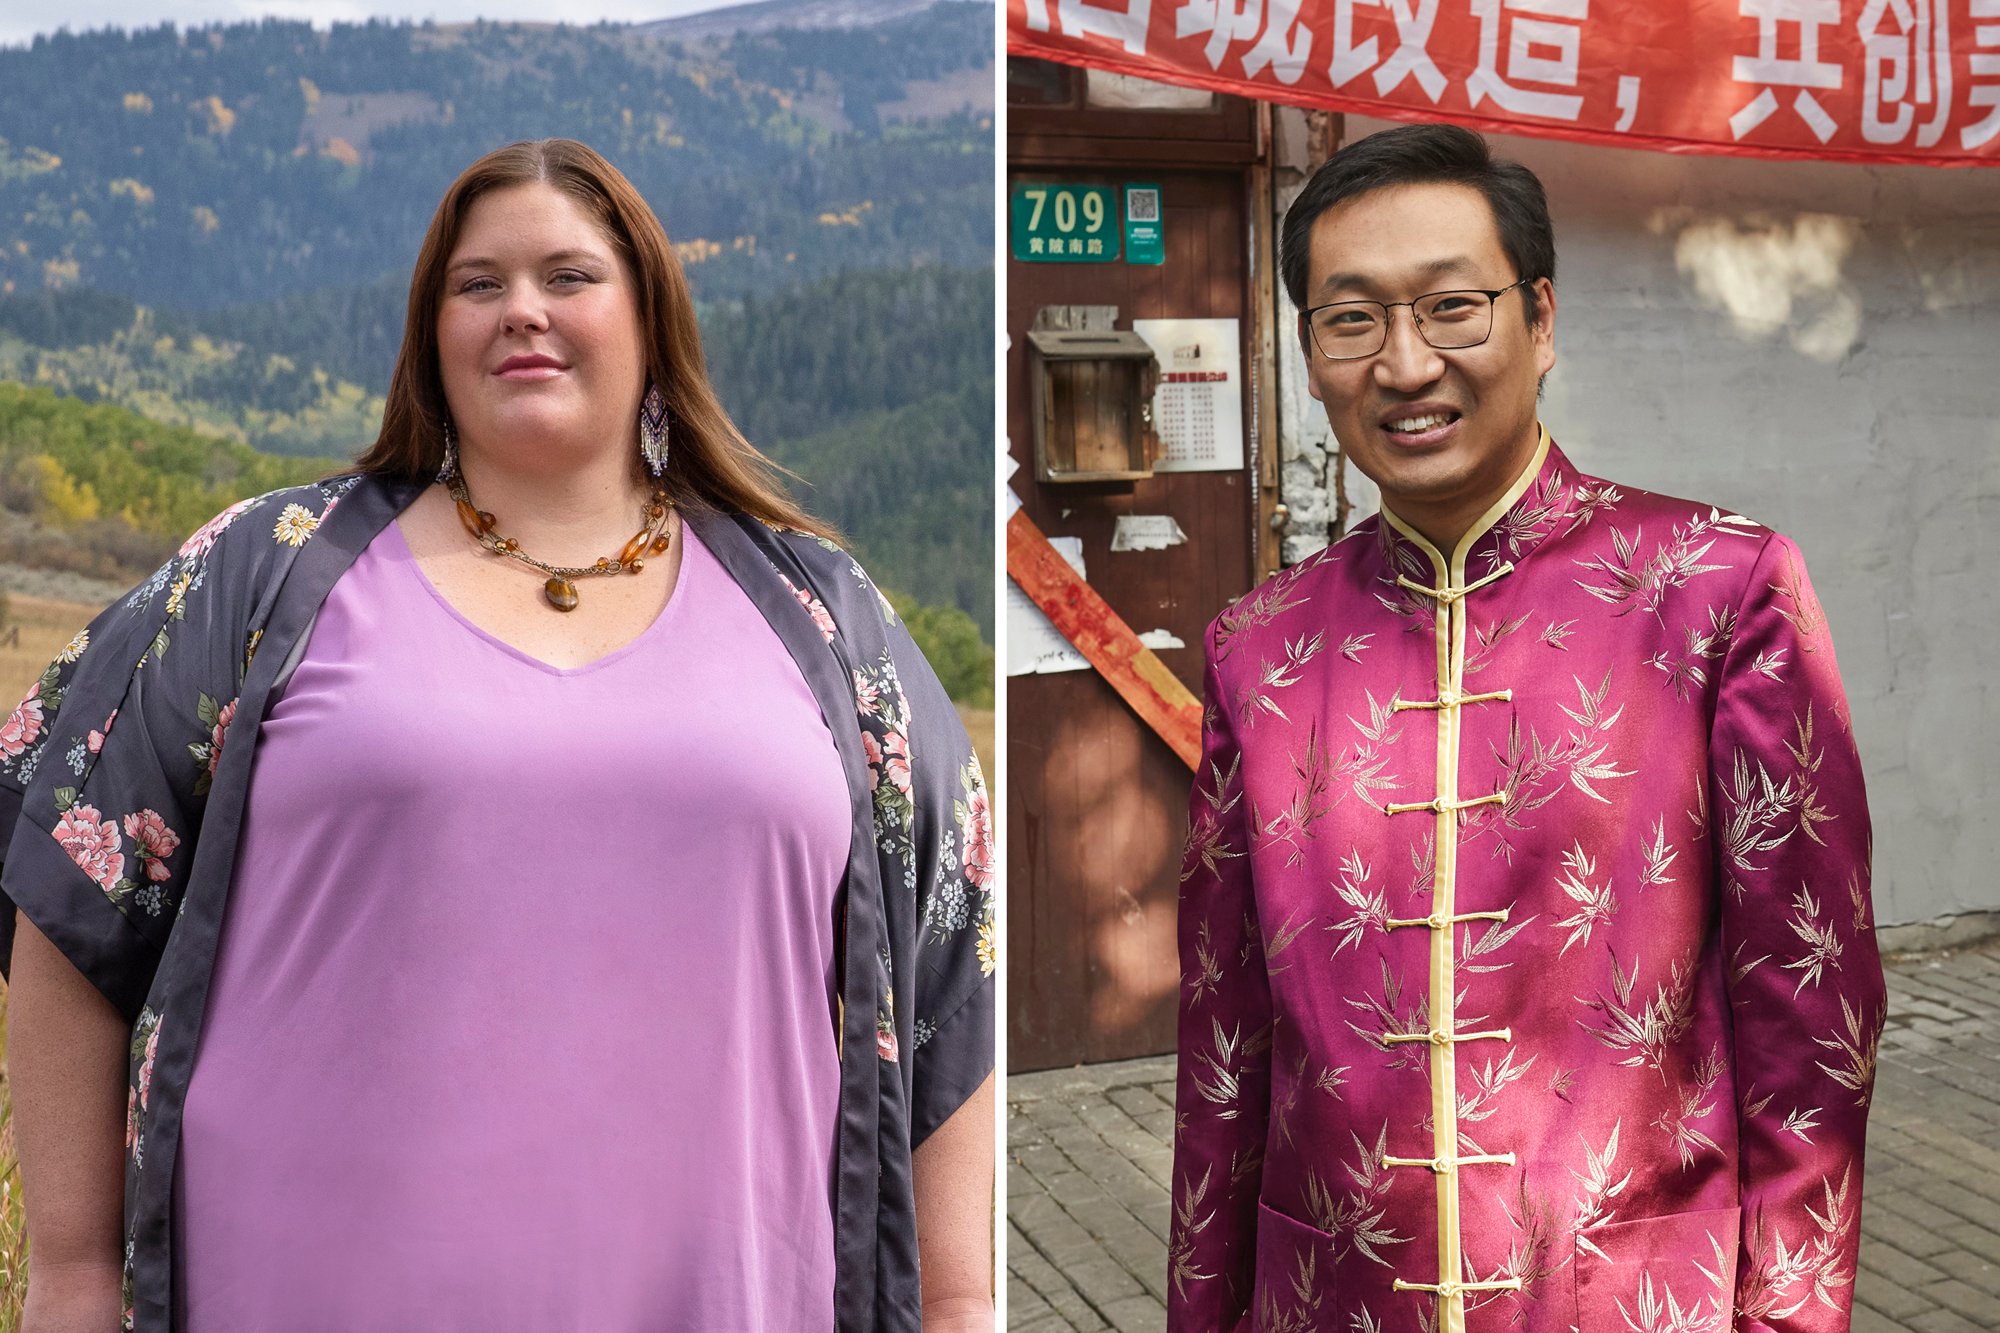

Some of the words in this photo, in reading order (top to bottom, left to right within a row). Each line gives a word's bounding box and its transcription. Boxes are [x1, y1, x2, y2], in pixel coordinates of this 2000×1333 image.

[1022, 0, 2000, 150] 城改造，共创
[1025, 190, 1104, 233] 709
[1029, 237, 1103, 254] 黄陂南路
